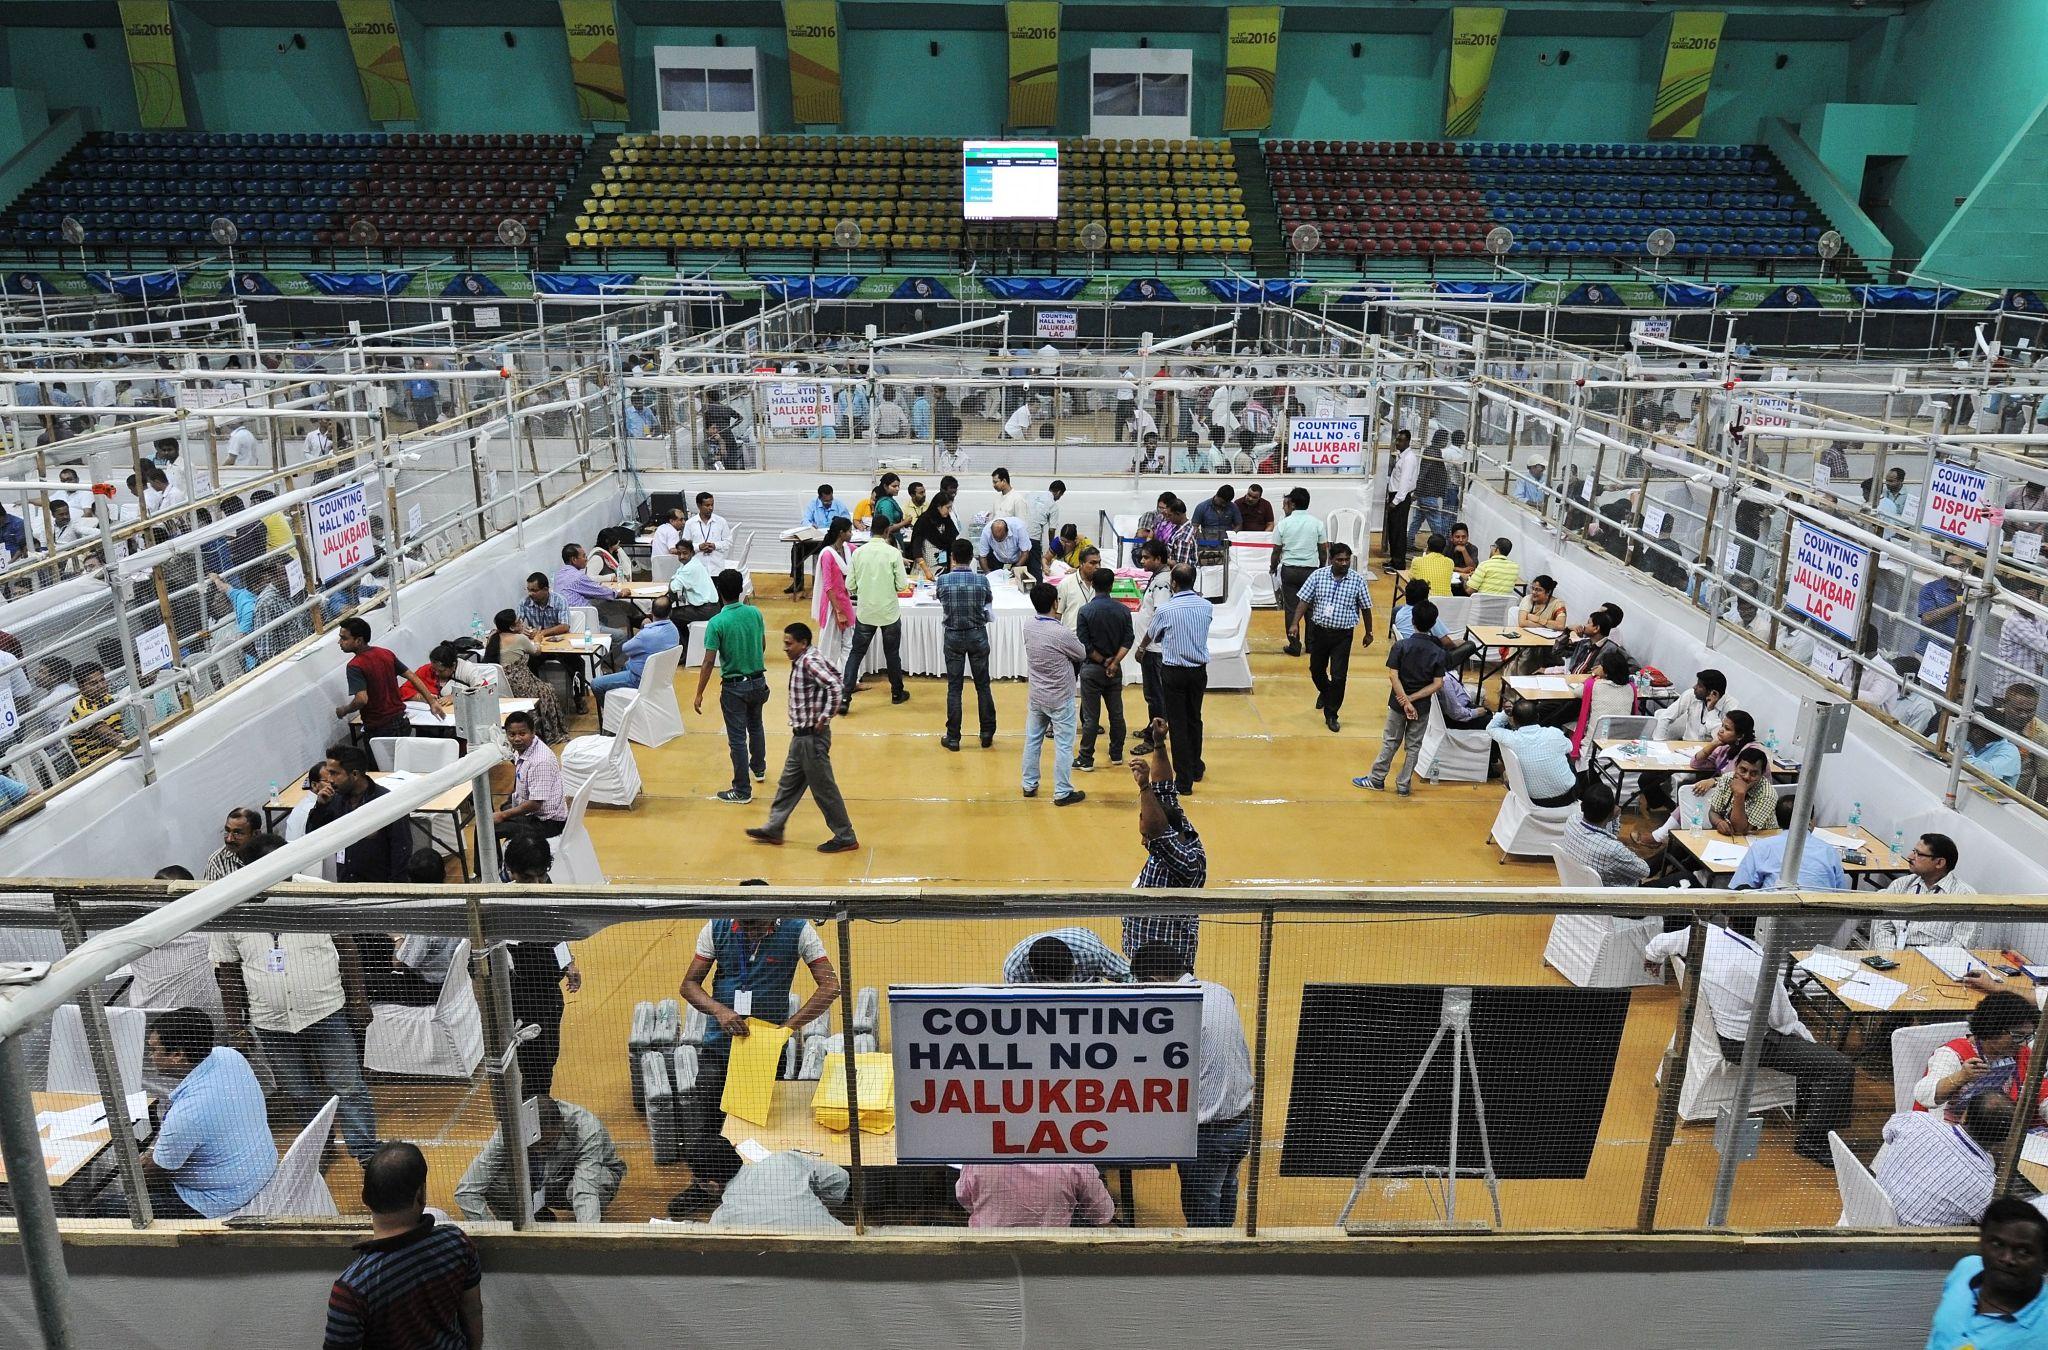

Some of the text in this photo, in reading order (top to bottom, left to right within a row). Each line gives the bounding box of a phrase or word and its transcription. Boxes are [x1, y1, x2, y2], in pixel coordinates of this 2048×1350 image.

[144, 24, 172, 36] 2016
[366, 23, 396, 34] 2016
[588, 24, 614, 36] 2016
[807, 26, 836, 38] 2016
[1028, 28, 1056, 40] 2016
[1249, 32, 1276, 44] 2016
[1471, 34, 1498, 46] 2016
[1688, 38, 1716, 50] 2016
[67, 280, 86, 289] 2016
[202, 280, 222, 290] 2016
[288, 280, 308, 290] 2016
[874, 284, 894, 293] 2016
[962, 285, 982, 294] 2016
[1098, 286, 1118, 295] 2016
[1186, 286, 1206, 296] 2016
[1546, 290, 1566, 299] 2016
[1634, 292, 1654, 300] 2016
[1744, 292, 1764, 301] 2016
[1831, 294, 1851, 302] 2016
[774, 387, 826, 395] CNTING
[773, 405, 831, 415] JALUKBRI
[790, 416, 816, 425] LAC
[1298, 422, 1357, 430] COUNTING
[1293, 442, 1360, 452] JALUKBARI
[1312, 454, 1340, 464] LAC
[1939, 469, 1985, 490] COUNTIN
[1932, 480, 1976, 502] HALL NO
[320, 491, 362, 517] COUNTING
[1933, 496, 1982, 524] DISPUR
[319, 516, 341, 535] HALL
[343, 510, 355, 525] NO
[362, 505, 366, 516] 6
[1940, 516, 1967, 536] LAC
[1655, 524, 1660, 533] 2
[323, 521, 370, 556] JALUKBARI
[1804, 533, 1858, 567] COUNTING
[0, 558, 5, 569] 3
[339, 546, 360, 569] LAC
[1730, 558, 1734, 570] 3
[1798, 547, 1823, 571] HALL
[1826, 561, 1842, 579] NO
[1852, 573, 1859, 587] 6
[1794, 566, 1856, 610] JALUKBARI
[1806, 594, 1833, 622] LAC
[160, 644, 170, 659] 10
[1829, 662, 1834, 674] 4
[1942, 672, 1949, 685] 5
[5, 711, 14, 726] 9
[922, 1007, 1175, 1036] COUNTING
[909, 1043, 1033, 1071] HALL
[1050, 1042, 1118, 1070] NO
[1162, 1041, 1190, 1070] 6
[910, 1078, 1190, 1114] JALUKBARI
[992, 1119, 1109, 1155] LAC
